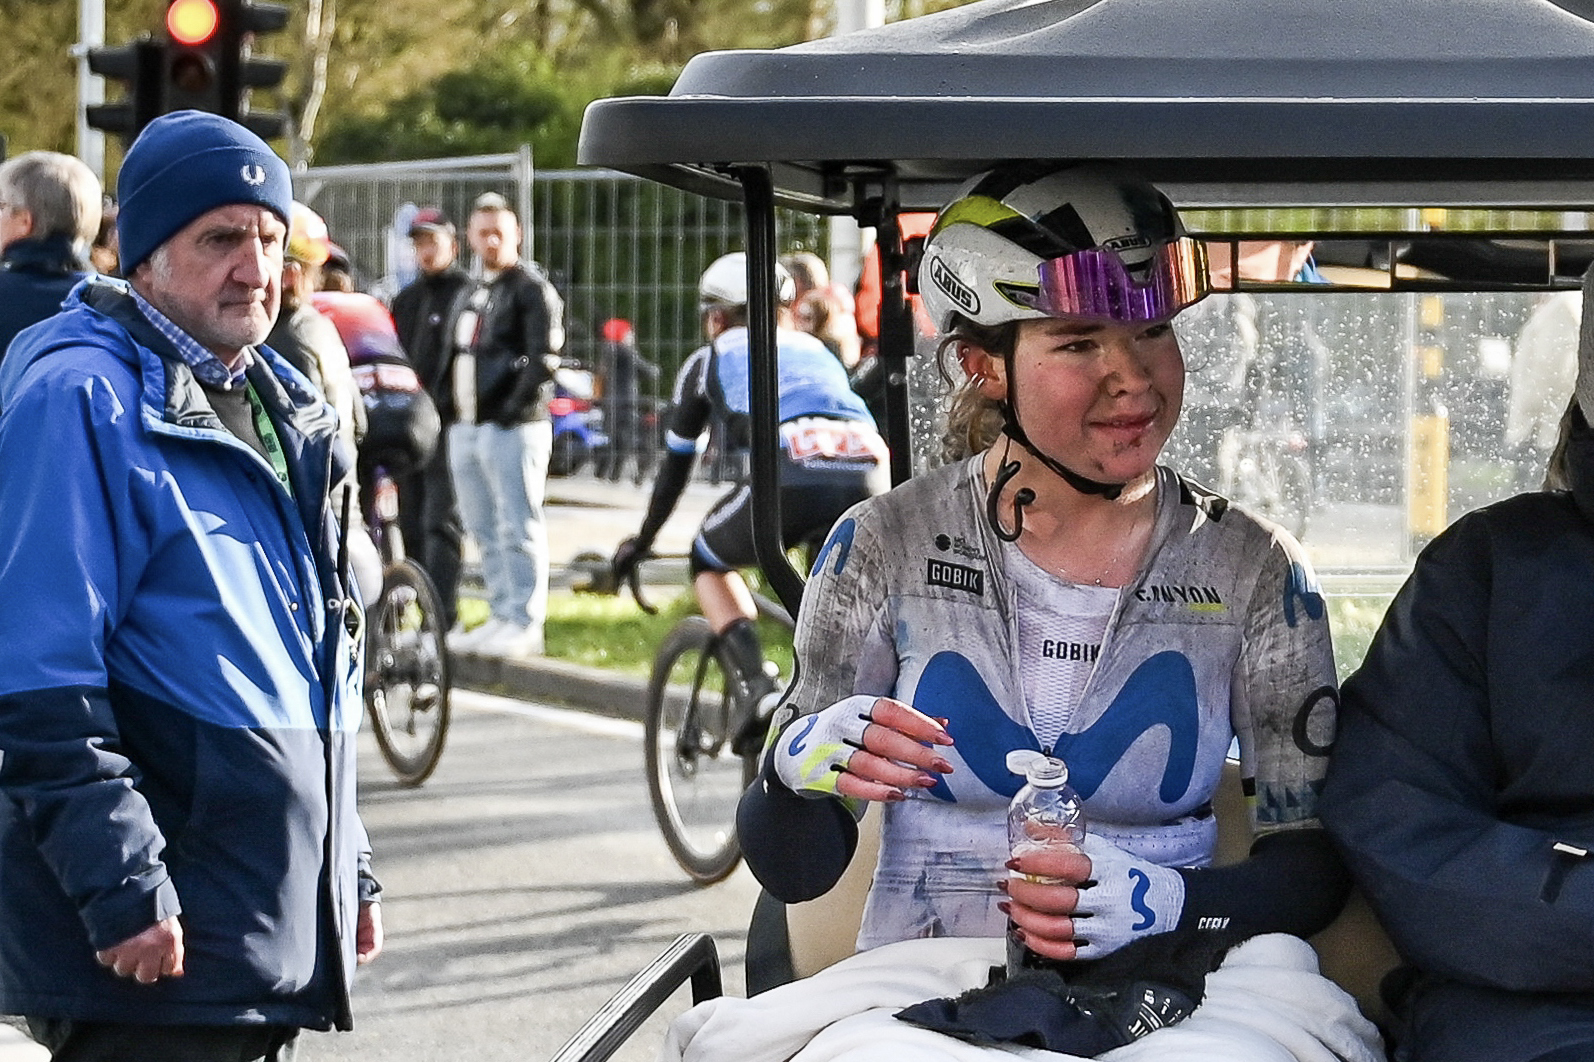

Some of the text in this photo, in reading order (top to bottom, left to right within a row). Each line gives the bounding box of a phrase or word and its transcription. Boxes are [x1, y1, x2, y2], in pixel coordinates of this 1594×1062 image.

[934, 264, 972, 309] ABUS
[932, 564, 978, 590] GOBIK
[1042, 640, 1101, 663] GOBIK
